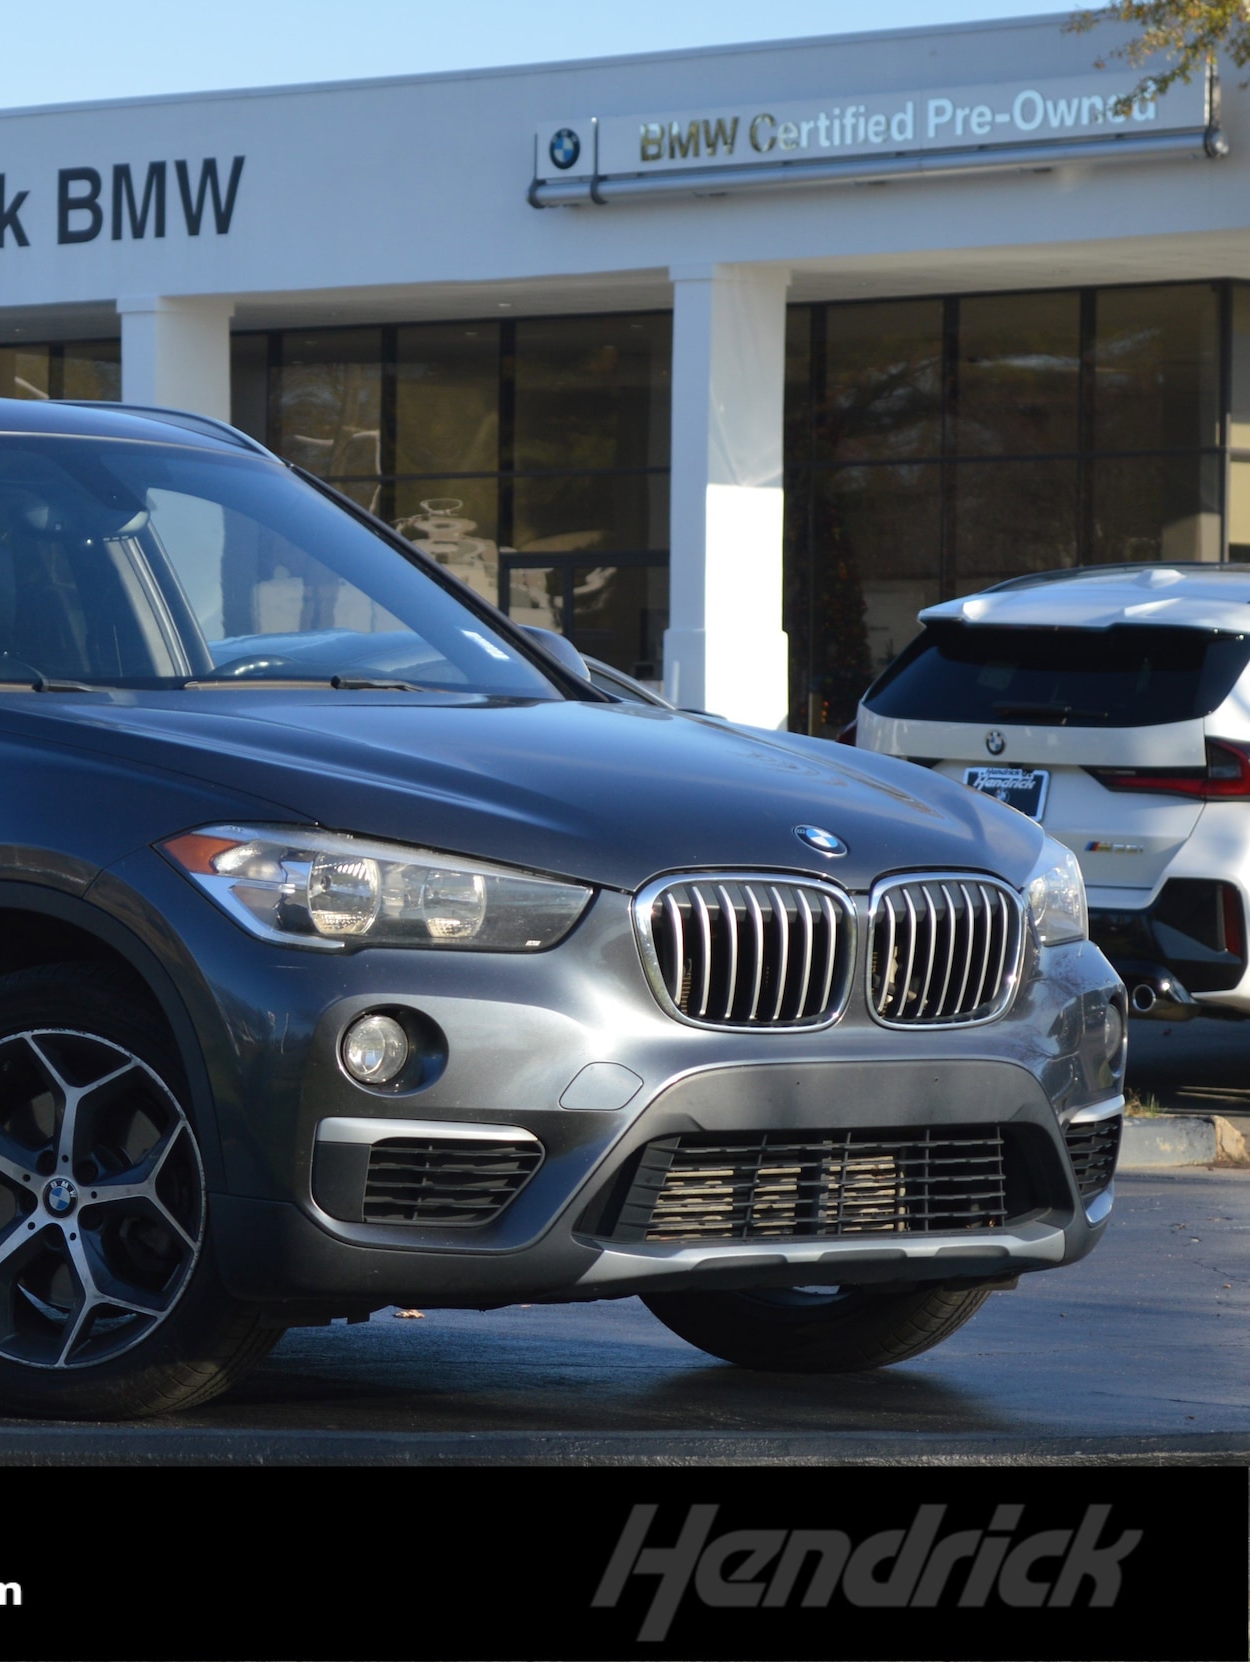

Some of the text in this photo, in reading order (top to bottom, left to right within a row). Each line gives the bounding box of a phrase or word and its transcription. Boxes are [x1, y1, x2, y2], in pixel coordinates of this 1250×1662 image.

[639, 116, 739, 162] BMW
[749, 101, 914, 153] Certified
[57, 155, 246, 246] BMW
[973, 775, 1036, 790] Hendrick
[51, 1181, 77, 1198] BMW
